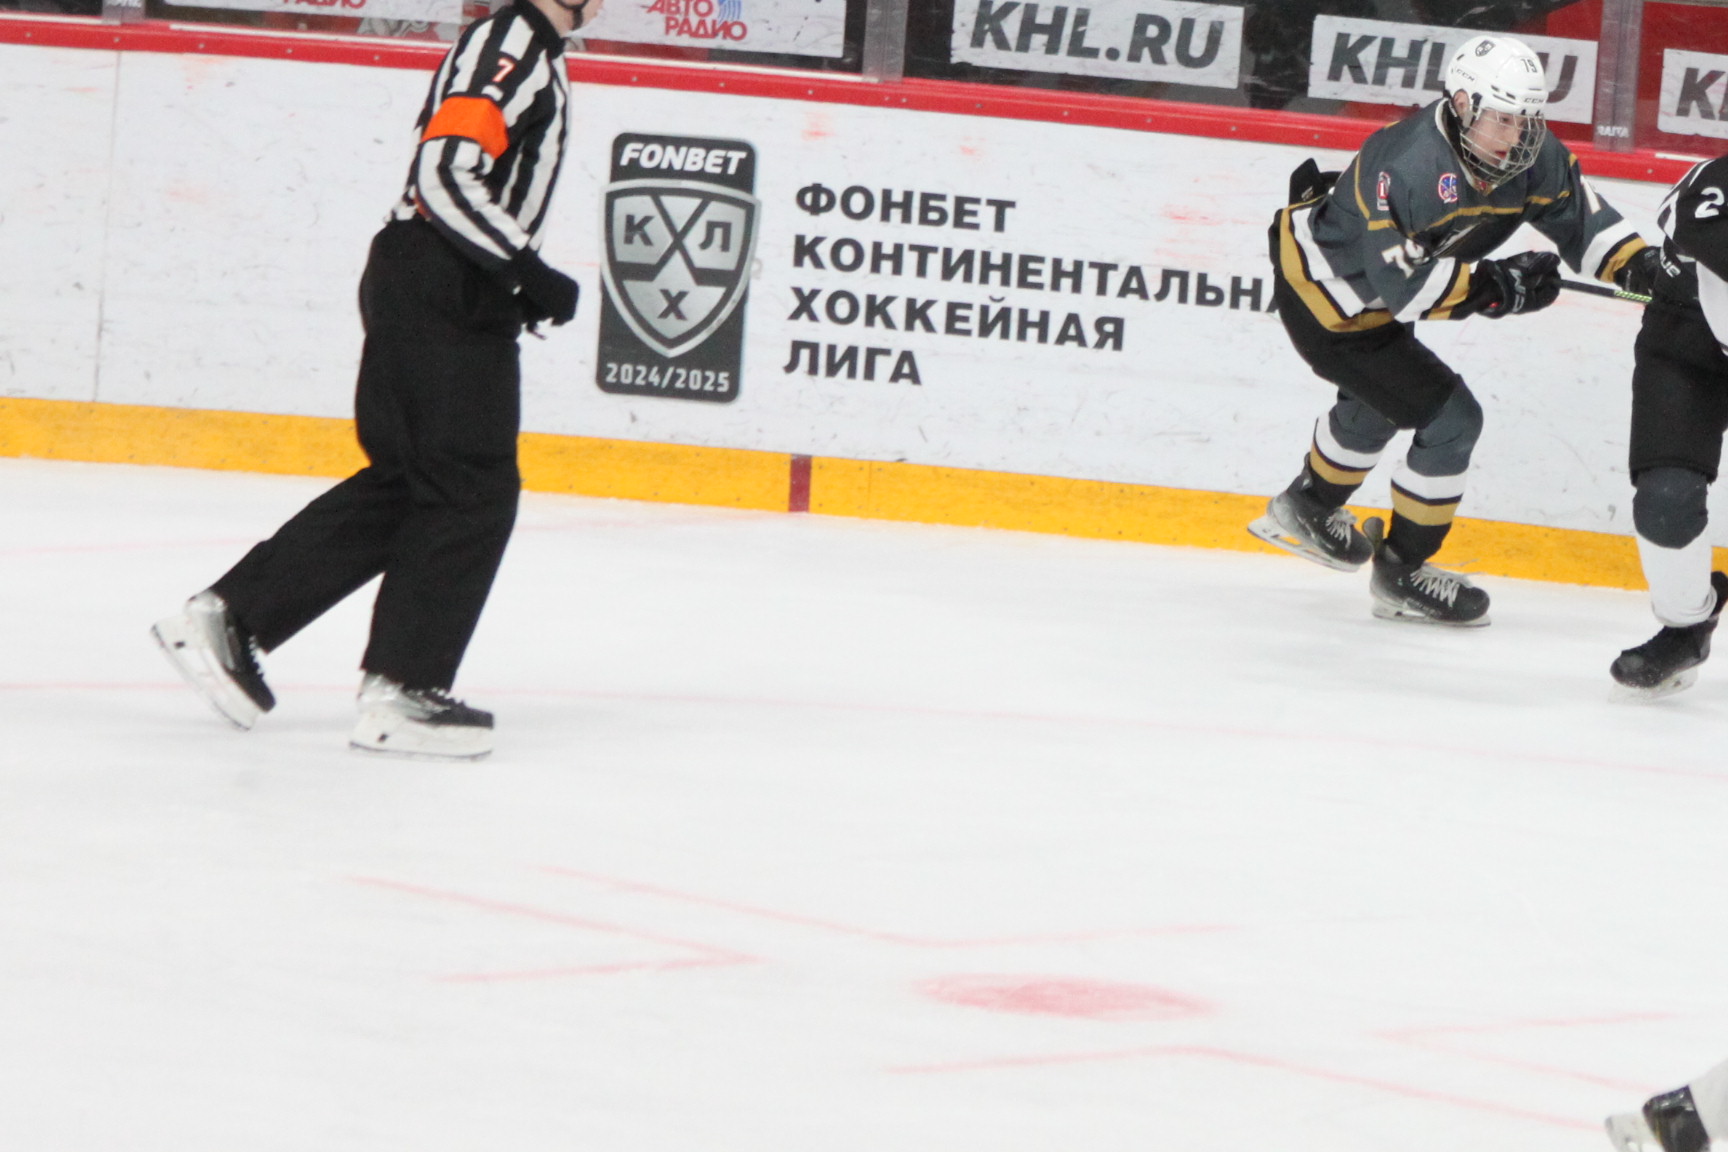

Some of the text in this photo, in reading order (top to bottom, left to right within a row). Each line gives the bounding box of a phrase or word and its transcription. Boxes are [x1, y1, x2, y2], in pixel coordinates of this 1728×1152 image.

[664, 16, 748, 41] РАДИО
[492, 57, 516, 83] 7
[620, 142, 747, 175] FONBET
[795, 182, 1017, 233] ФОНБЕТ
[792, 234, 1281, 314] КОНТИНЕНТАЛЬН
[787, 287, 1126, 352] ХОККЕЙНАЯ
[605, 363, 730, 392] 2024/2025
[783, 339, 922, 386] ЛИГА
